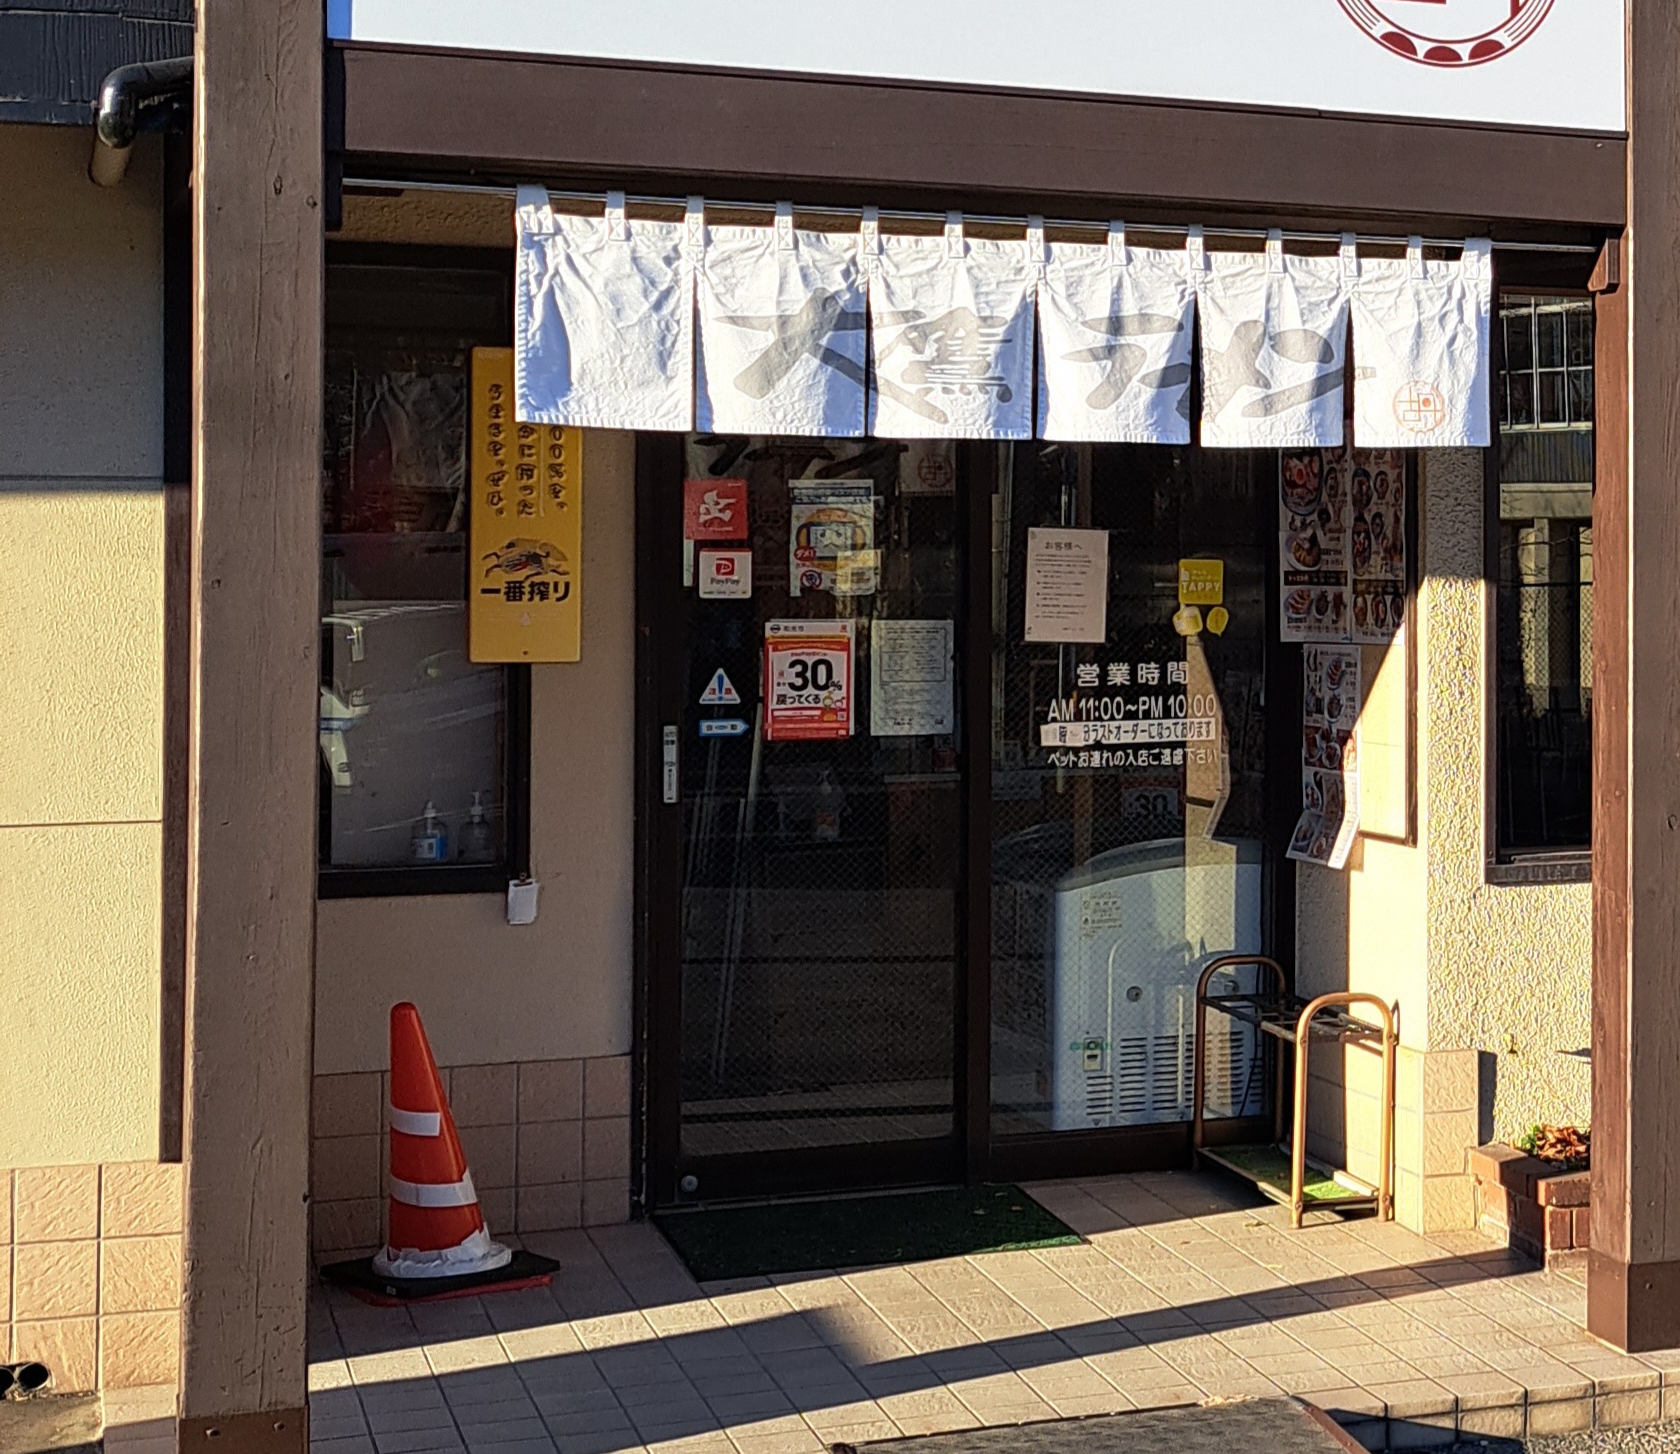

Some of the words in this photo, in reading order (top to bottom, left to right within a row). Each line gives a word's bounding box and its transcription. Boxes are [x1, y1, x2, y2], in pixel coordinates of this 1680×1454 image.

[1044, 541, 1083, 551] お客様へ
[709, 577, 741, 587] PayPay
[1181, 582, 1221, 594] TAPPY
[480, 579, 571, 603] 一番搾り
[1076, 661, 1189, 687] 営業時間
[775, 693, 822, 706] 戻ってくる
[1047, 698, 1075, 722] AM
